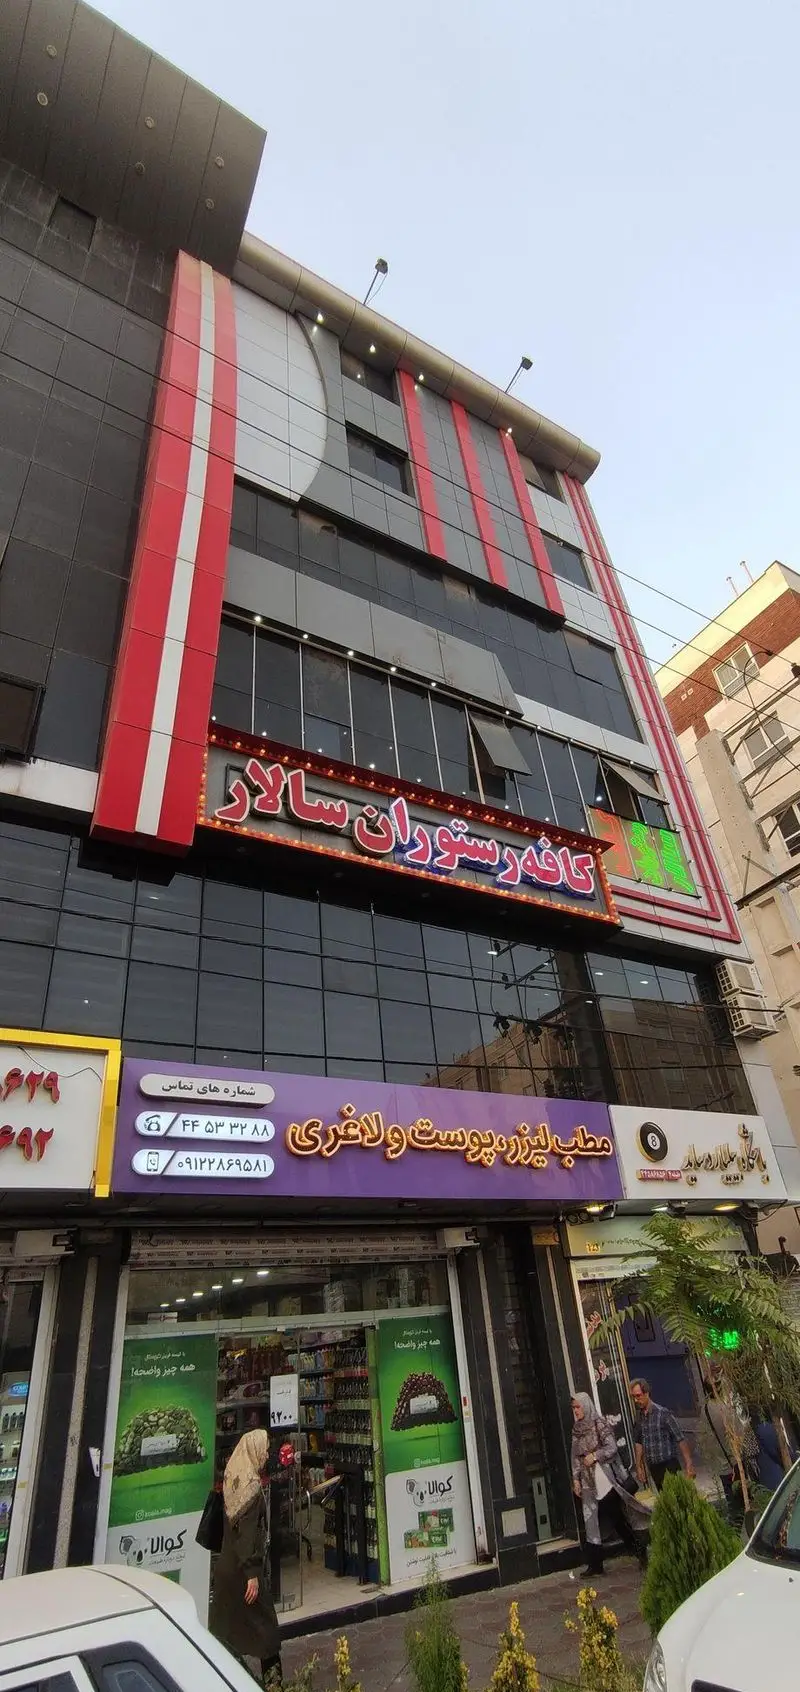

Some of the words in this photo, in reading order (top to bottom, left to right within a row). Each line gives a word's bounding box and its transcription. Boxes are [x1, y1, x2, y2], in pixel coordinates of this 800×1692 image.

[214, 758, 349, 829] سالار
[354, 796, 521, 886] رستوران
[520, 836, 596, 894] کافه
[0, 1067, 61, 1104] ۶۲۹
[161, 1080, 194, 1092] تماس
[196, 1082, 220, 1096] های
[223, 1085, 256, 1098] شماره
[285, 1102, 385, 1157] لاغری
[406, 1117, 496, 1168] پوست
[551, 1124, 613, 1168] مطب
[650, 1135, 658, 1147] 8
[177, 1156, 267, 1173] ۰۹۱۲۲۸۶۹۵۸۱
[416, 1340, 428, 1351] چیز
[428, 1338, 441, 1346] همه
[162, 1364, 178, 1377] چیز
[179, 1363, 196, 1372] همه
[427, 1475, 454, 1497] کوالا
[150, 1528, 188, 1557] کوالا
